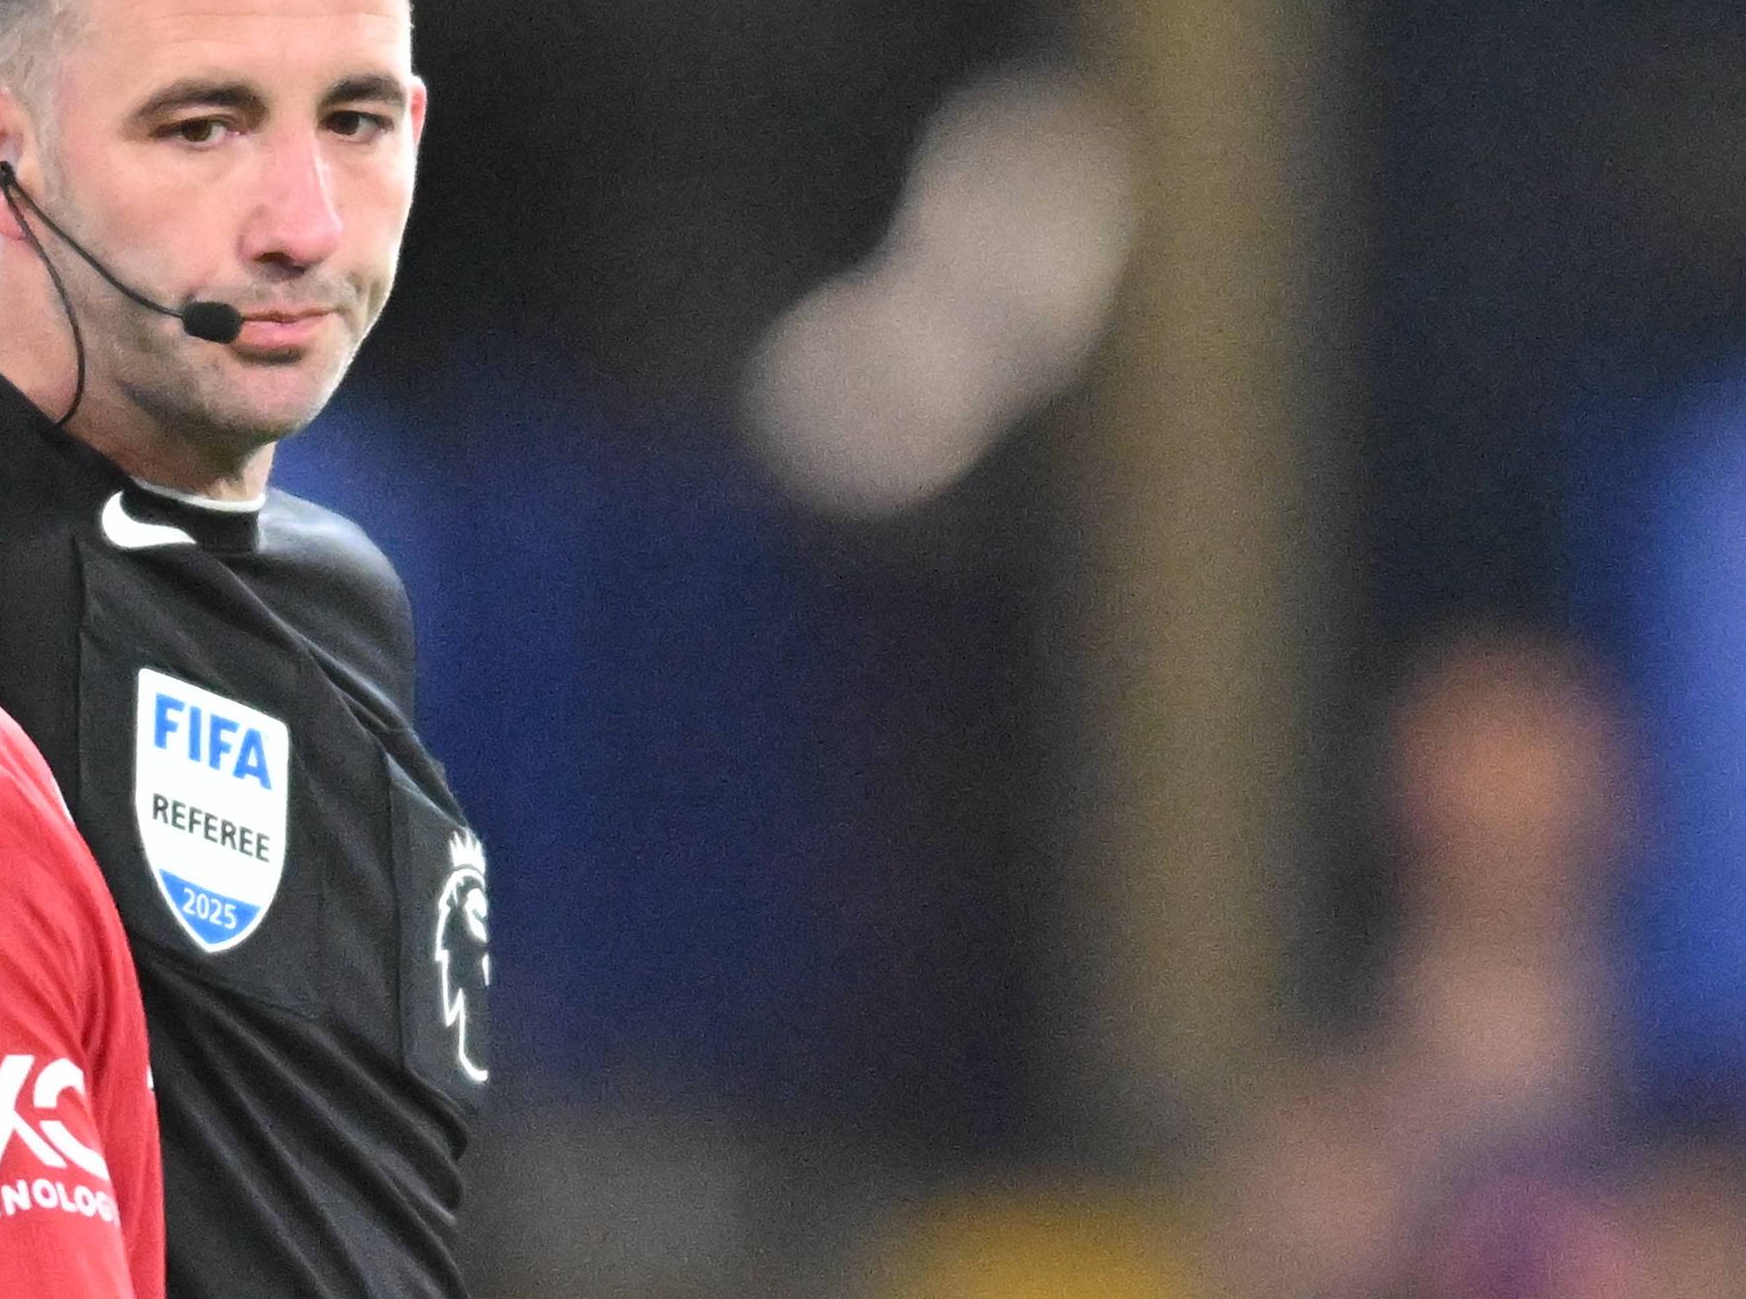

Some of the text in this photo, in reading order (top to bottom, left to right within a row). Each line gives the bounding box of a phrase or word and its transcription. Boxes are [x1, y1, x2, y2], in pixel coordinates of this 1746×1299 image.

[153, 691, 273, 791] FIFA
[151, 791, 271, 864] REFEREE
[181, 886, 238, 931] 2025
